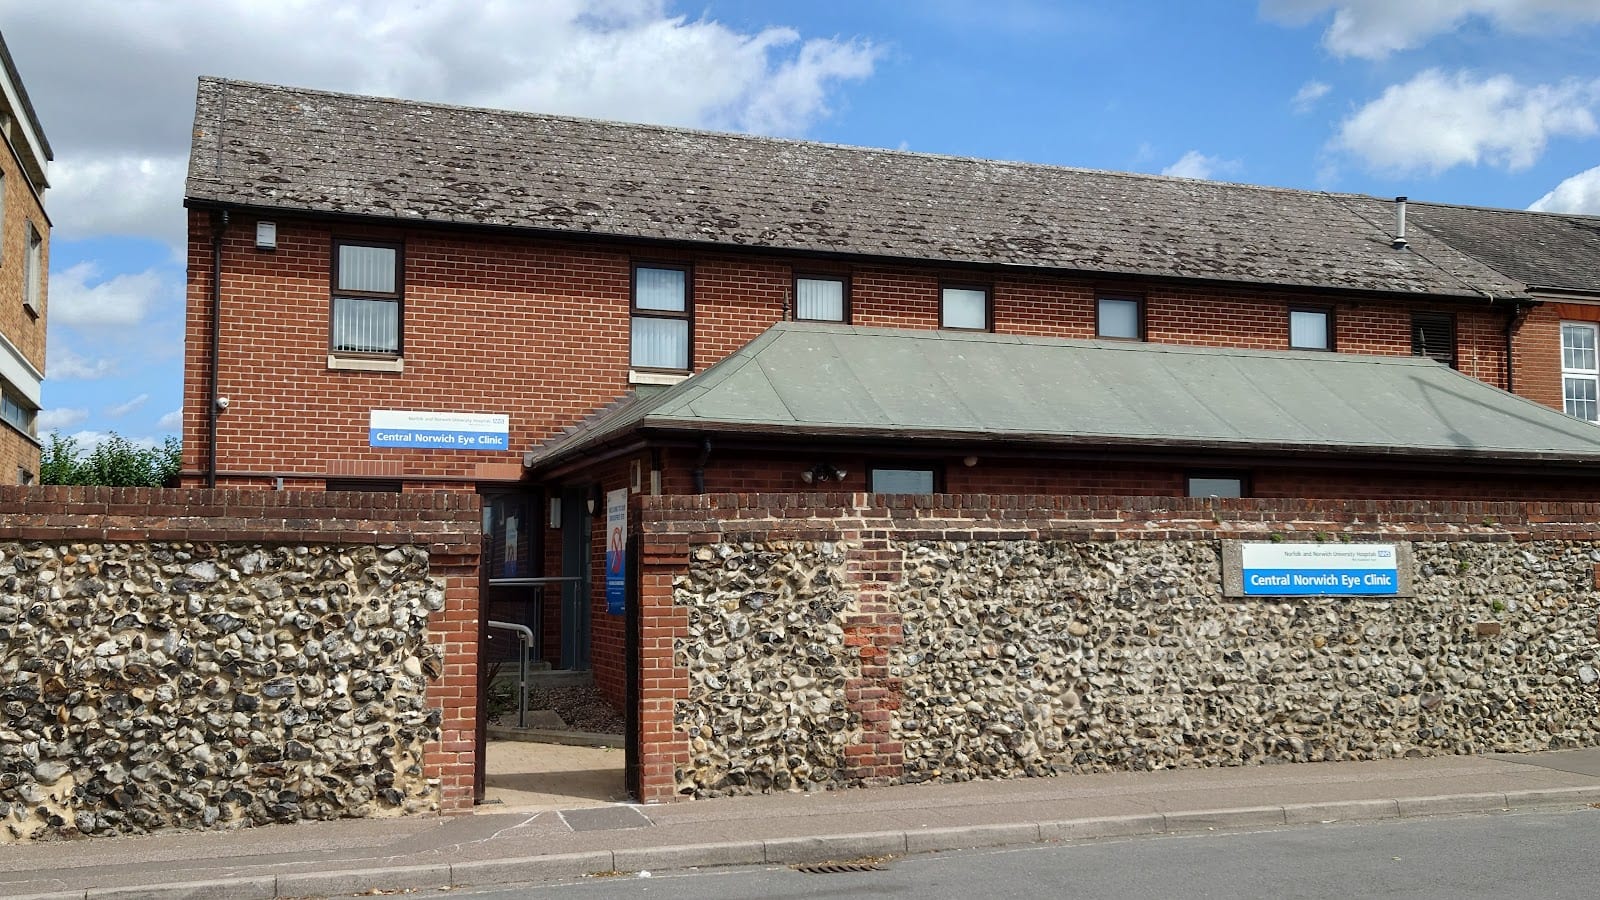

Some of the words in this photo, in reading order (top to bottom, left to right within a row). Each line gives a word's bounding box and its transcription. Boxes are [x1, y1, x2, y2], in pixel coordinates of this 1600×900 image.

[376, 432, 412, 443] Central
[415, 433, 455, 444] Norwich
[458, 435, 475, 446] Eye
[478, 435, 503, 445] Clinic
[1251, 574, 1290, 586] Central
[1293, 574, 1338, 586] Norwich
[1341, 574, 1361, 588] Eye
[1364, 574, 1391, 586] Clinic
